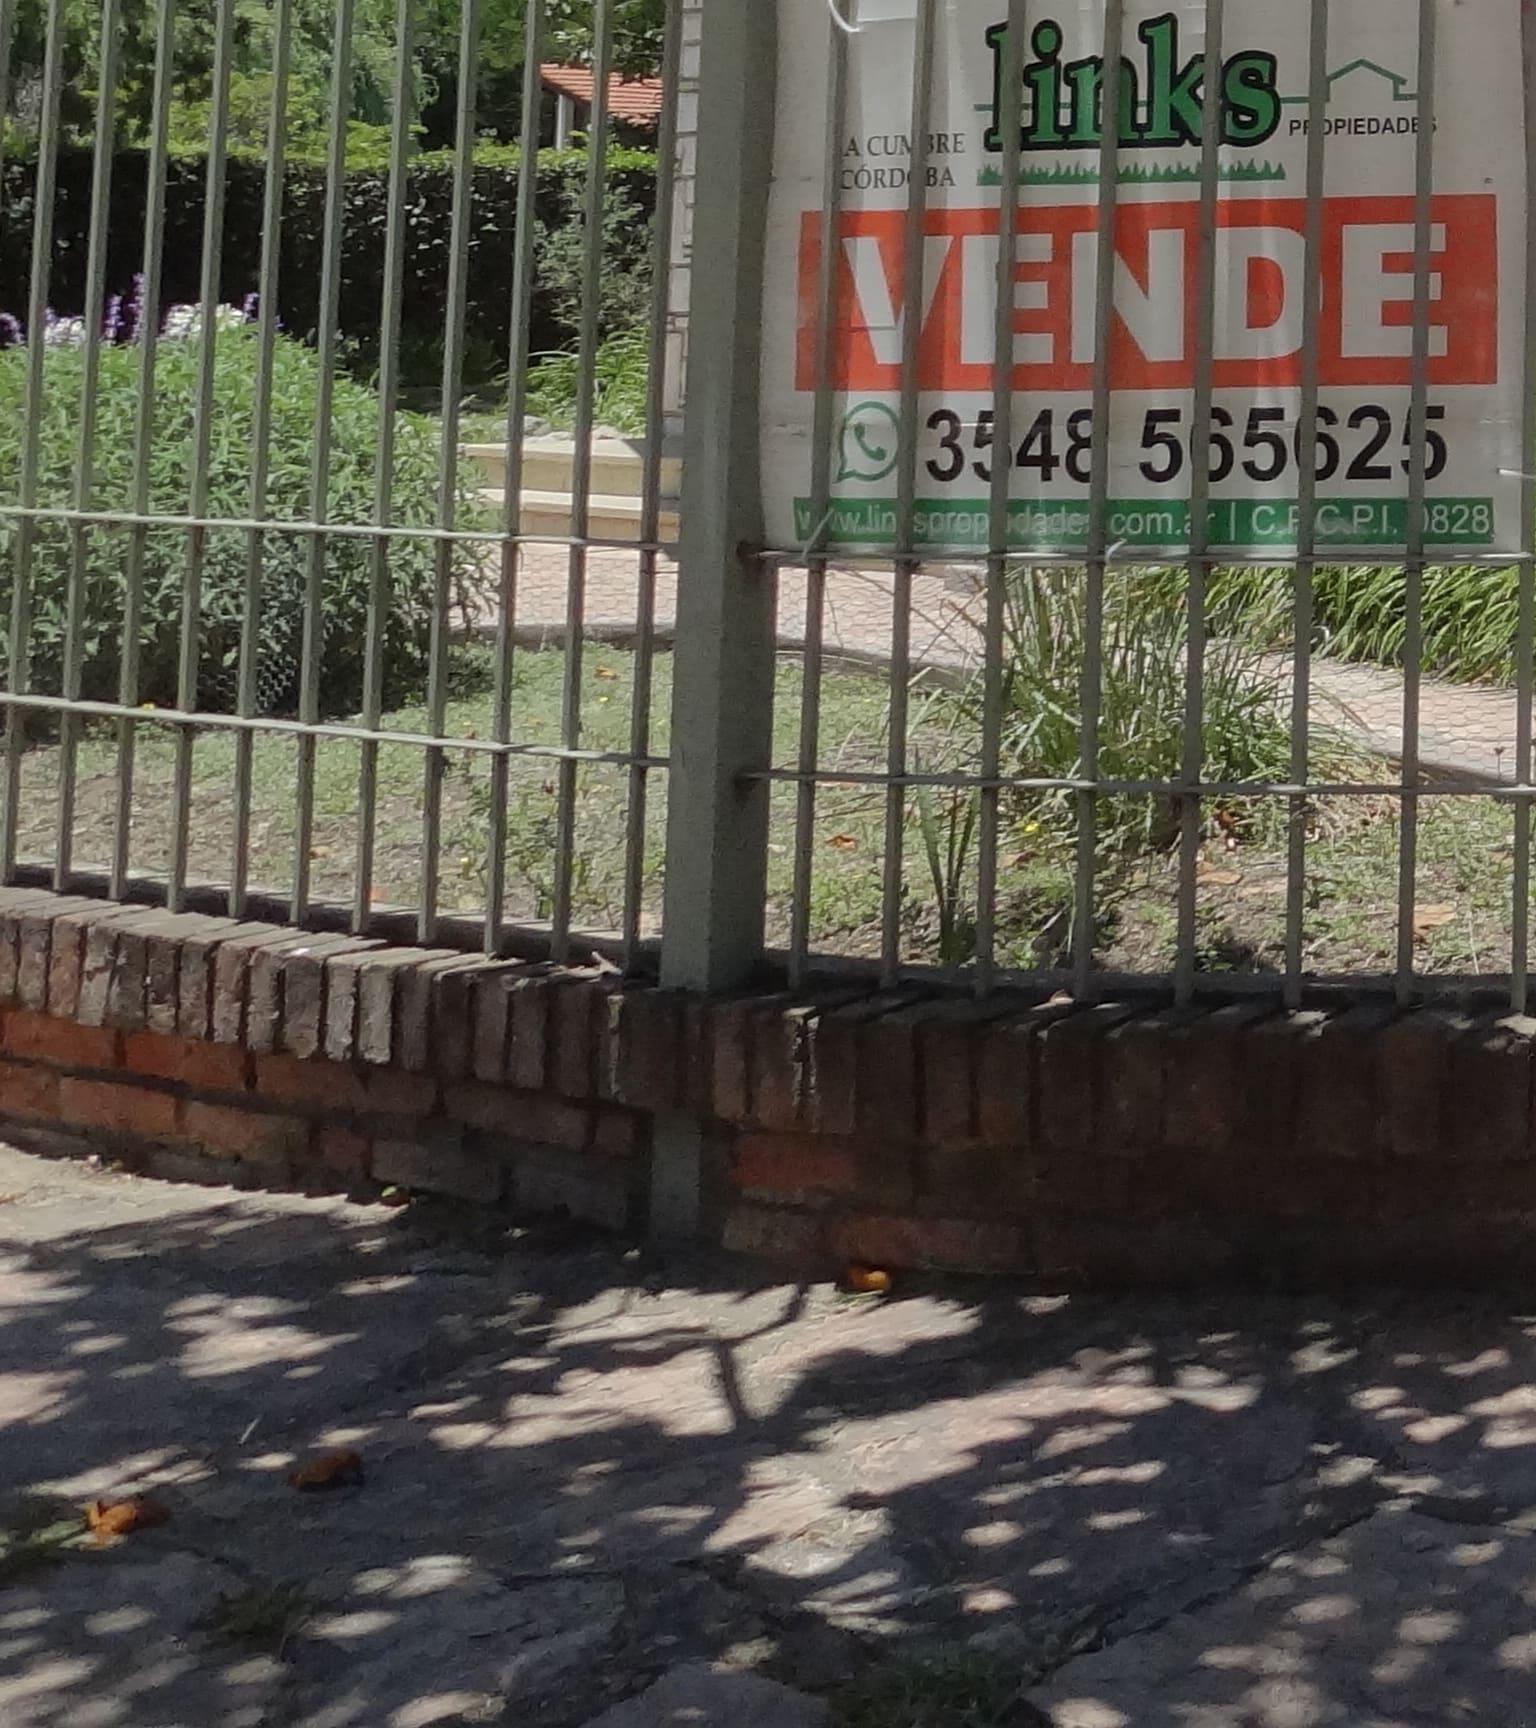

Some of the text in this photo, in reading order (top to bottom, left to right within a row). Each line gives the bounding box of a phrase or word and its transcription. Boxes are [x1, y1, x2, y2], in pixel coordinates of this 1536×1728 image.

[984, 12, 1281, 152] links
[839, 164, 955, 189] CÓRDBA
[842, 223, 1448, 365] VENDE
[1139, 404, 1447, 482] 565625
